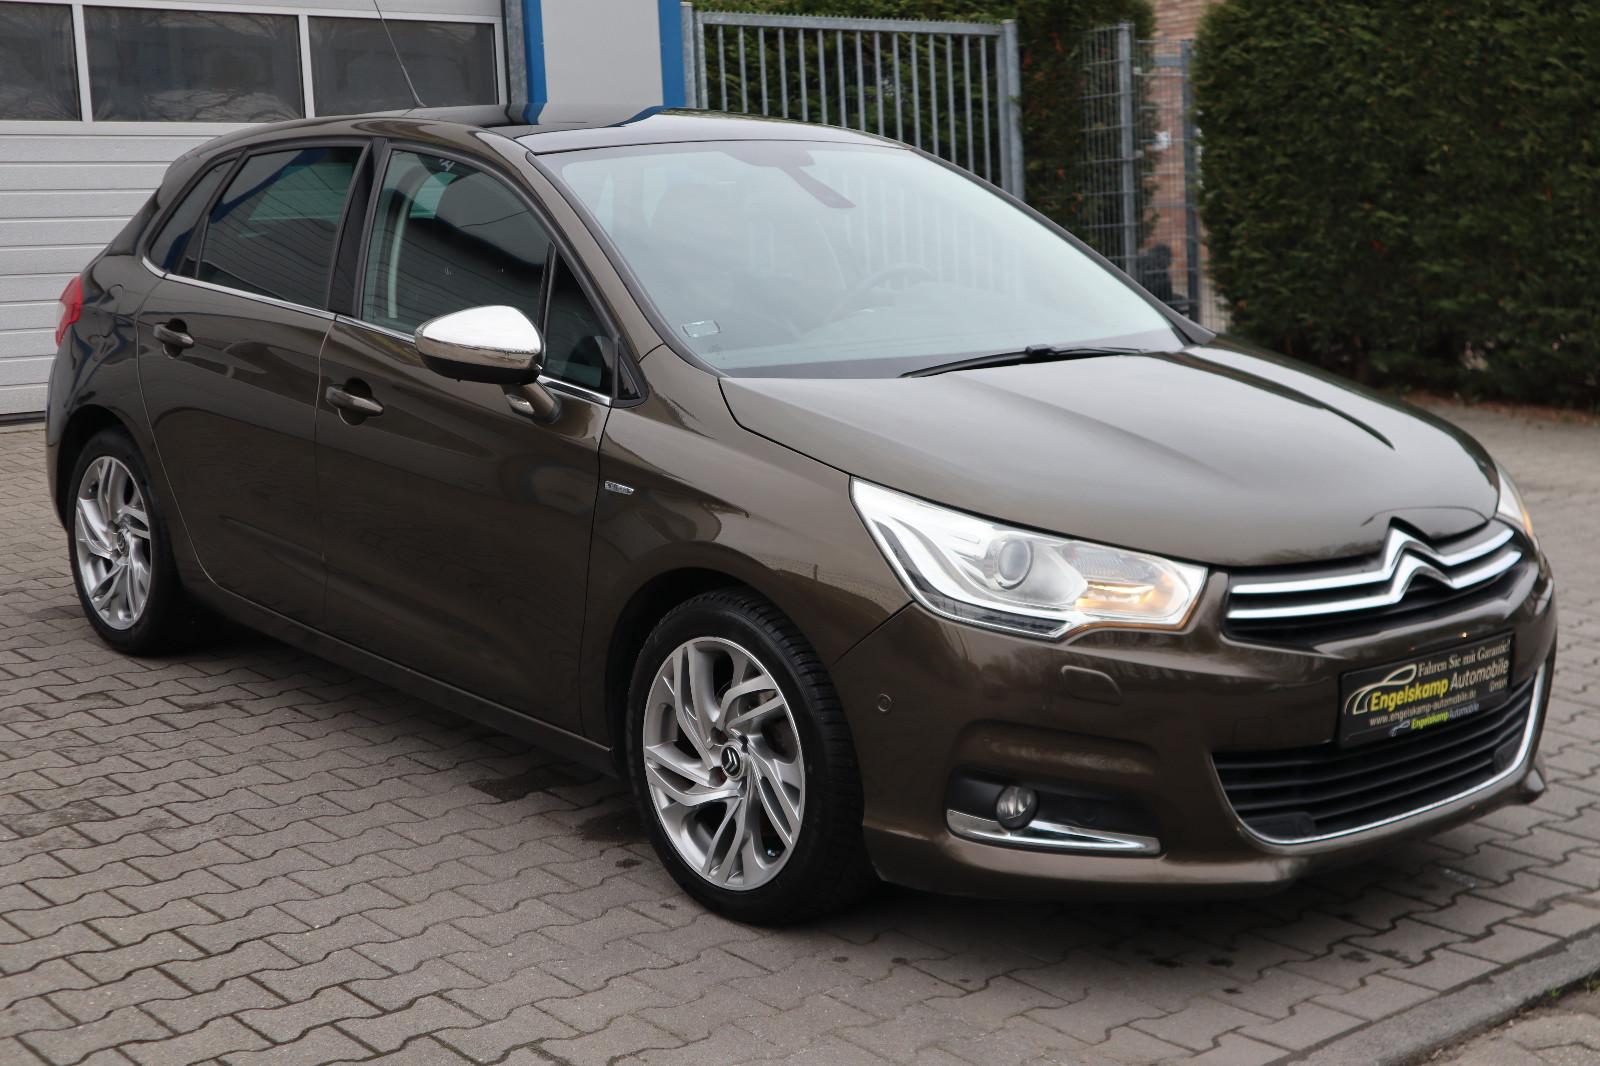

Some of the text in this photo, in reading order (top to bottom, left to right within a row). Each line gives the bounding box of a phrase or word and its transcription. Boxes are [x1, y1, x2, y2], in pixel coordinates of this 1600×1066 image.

[1418, 661, 1448, 677] Fahren
[1449, 654, 1462, 668] Sie
[1462, 650, 1476, 665] mit
[1370, 658, 1510, 712] Engelskamp Automobile
[1411, 711, 1449, 730] Engelskamp
